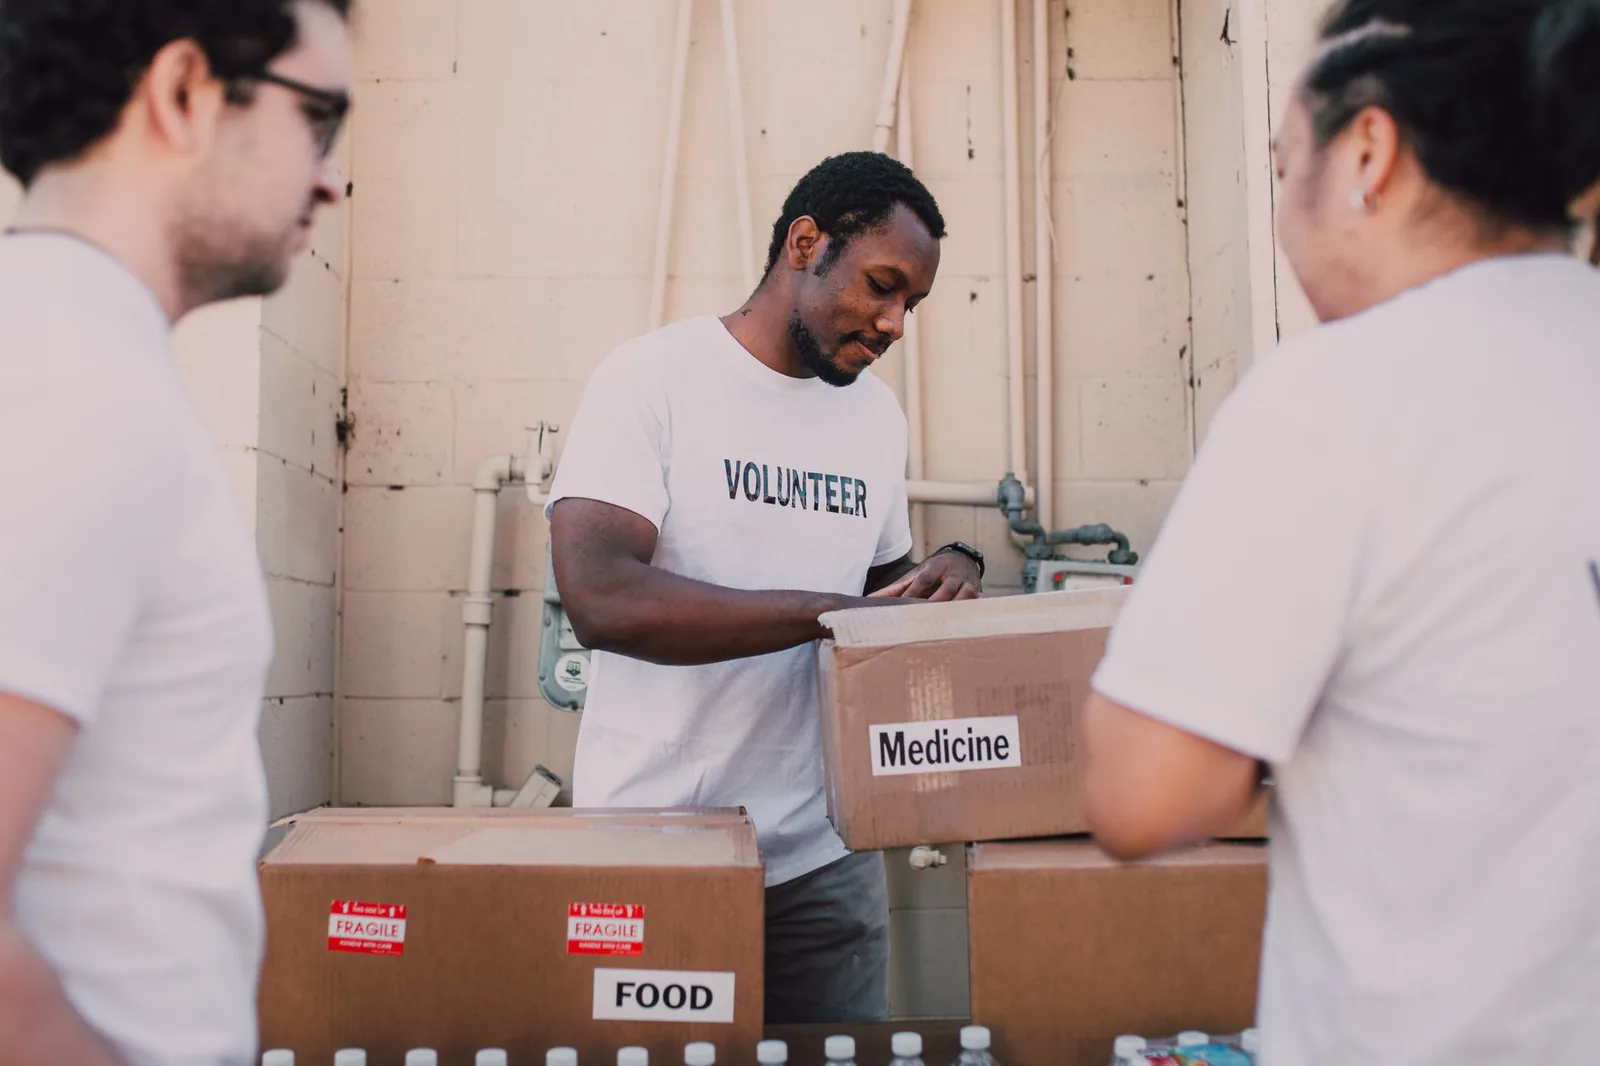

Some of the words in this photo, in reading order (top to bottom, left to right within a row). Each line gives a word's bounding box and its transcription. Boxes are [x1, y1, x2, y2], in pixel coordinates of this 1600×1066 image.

[724, 458, 867, 518] VOLUNTEER
[879, 727, 1009, 767] Medicine
[336, 920, 399, 938] FRAGILE
[575, 922, 637, 938] FRAGILE
[616, 982, 713, 1010] FOOD
